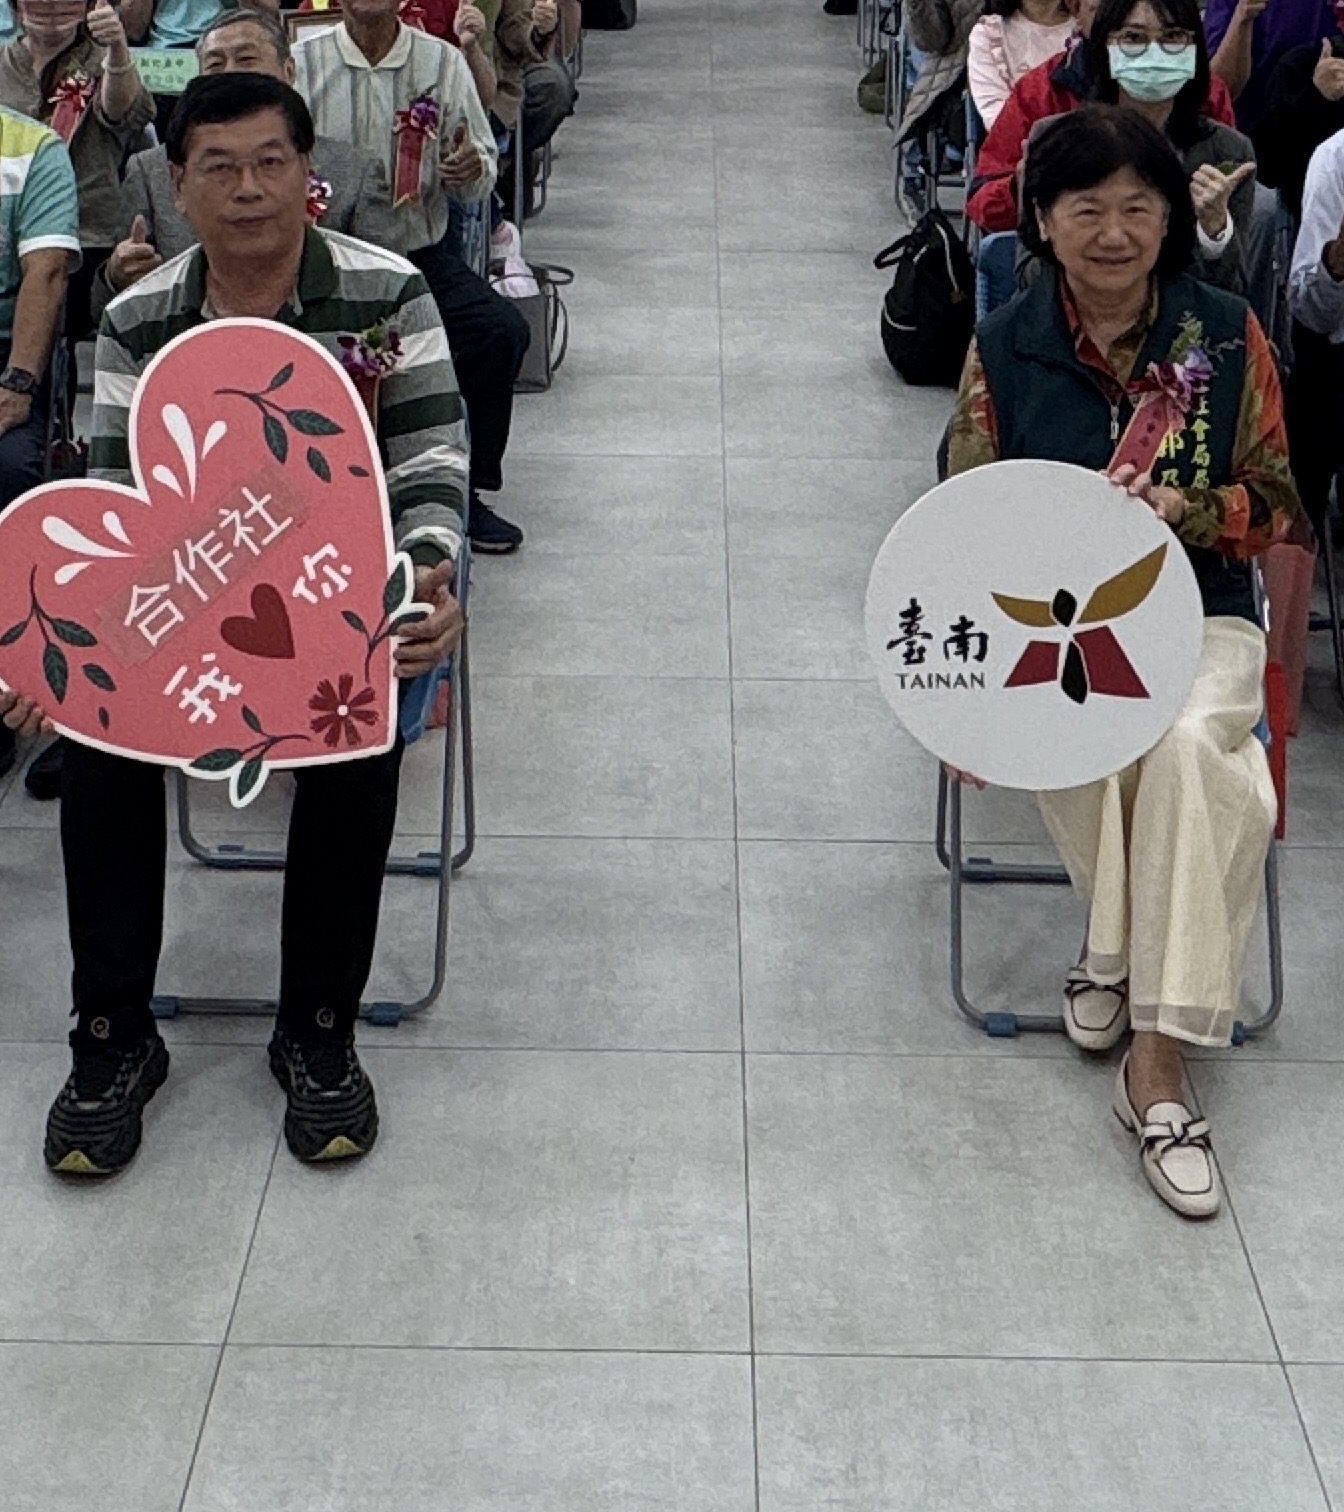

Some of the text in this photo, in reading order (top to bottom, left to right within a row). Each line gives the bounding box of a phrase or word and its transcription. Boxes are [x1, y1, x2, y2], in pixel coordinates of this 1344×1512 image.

[123, 486, 293, 647] 合作社
[163, 542, 352, 724] 我 你
[887, 597, 989, 665] 臺南
[895, 672, 986, 689] TAINAN
